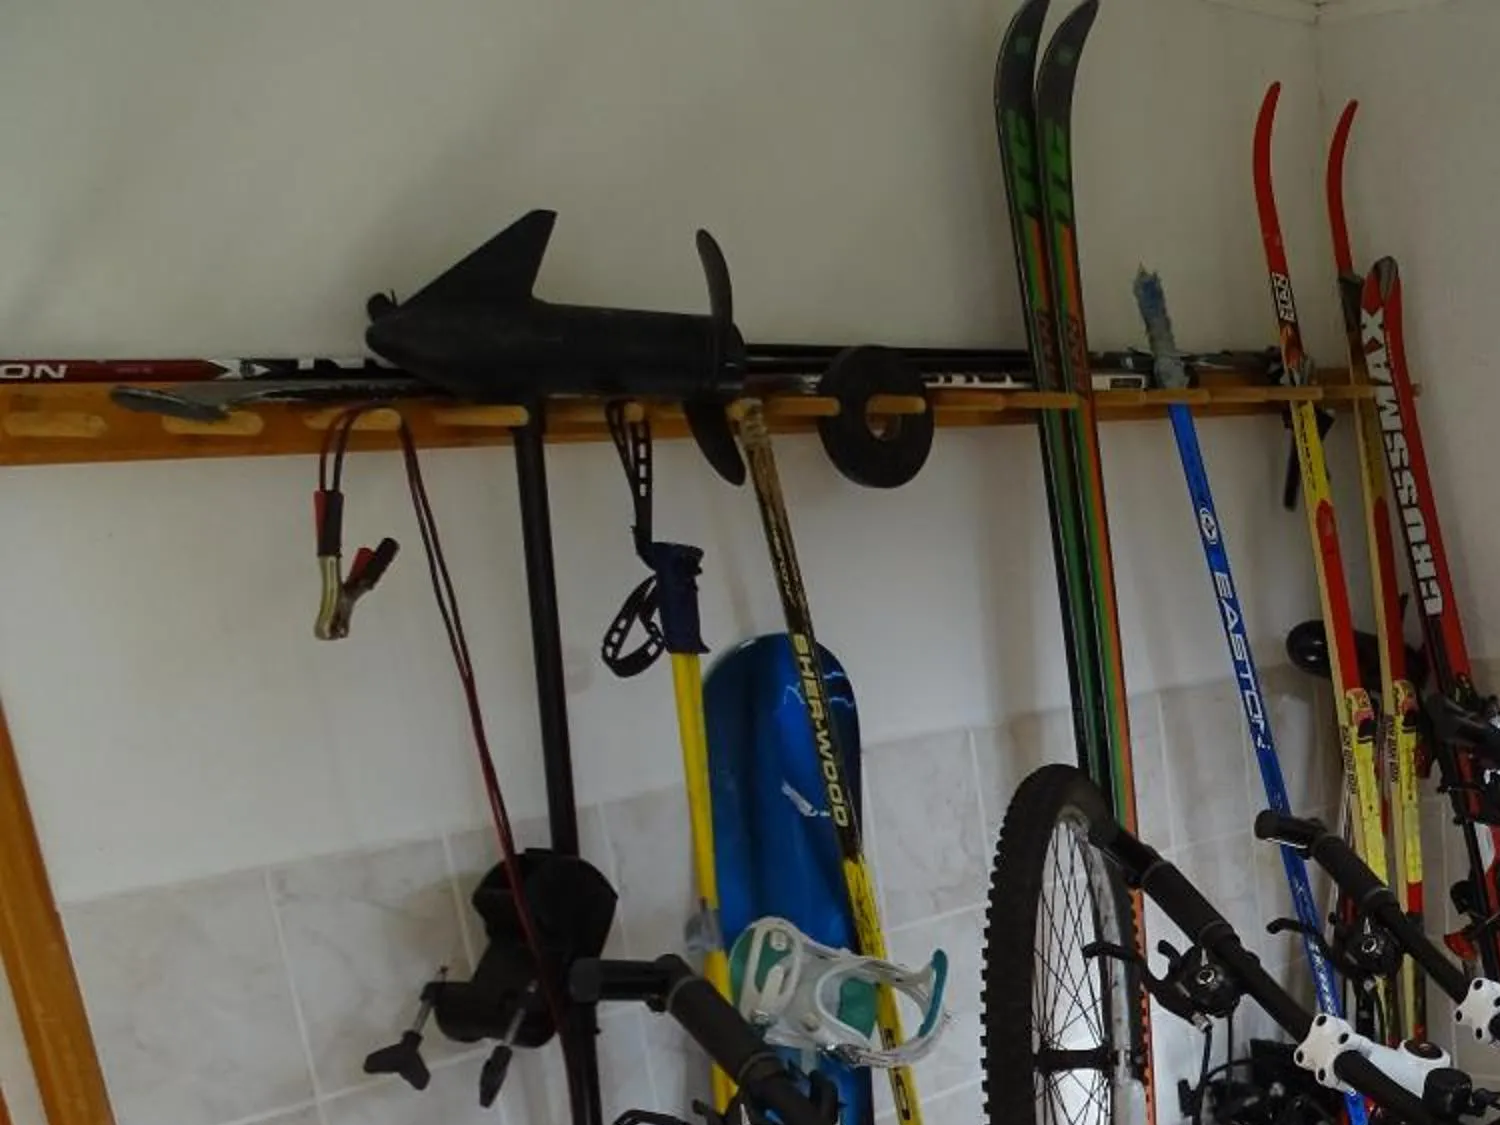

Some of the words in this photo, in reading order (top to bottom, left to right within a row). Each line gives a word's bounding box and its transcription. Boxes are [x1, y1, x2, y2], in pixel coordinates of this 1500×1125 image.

[1359, 306, 1445, 618] CROSSMAX
[790, 632, 850, 828] SHER-WOOD
[1211, 570, 1272, 754] EASTON
